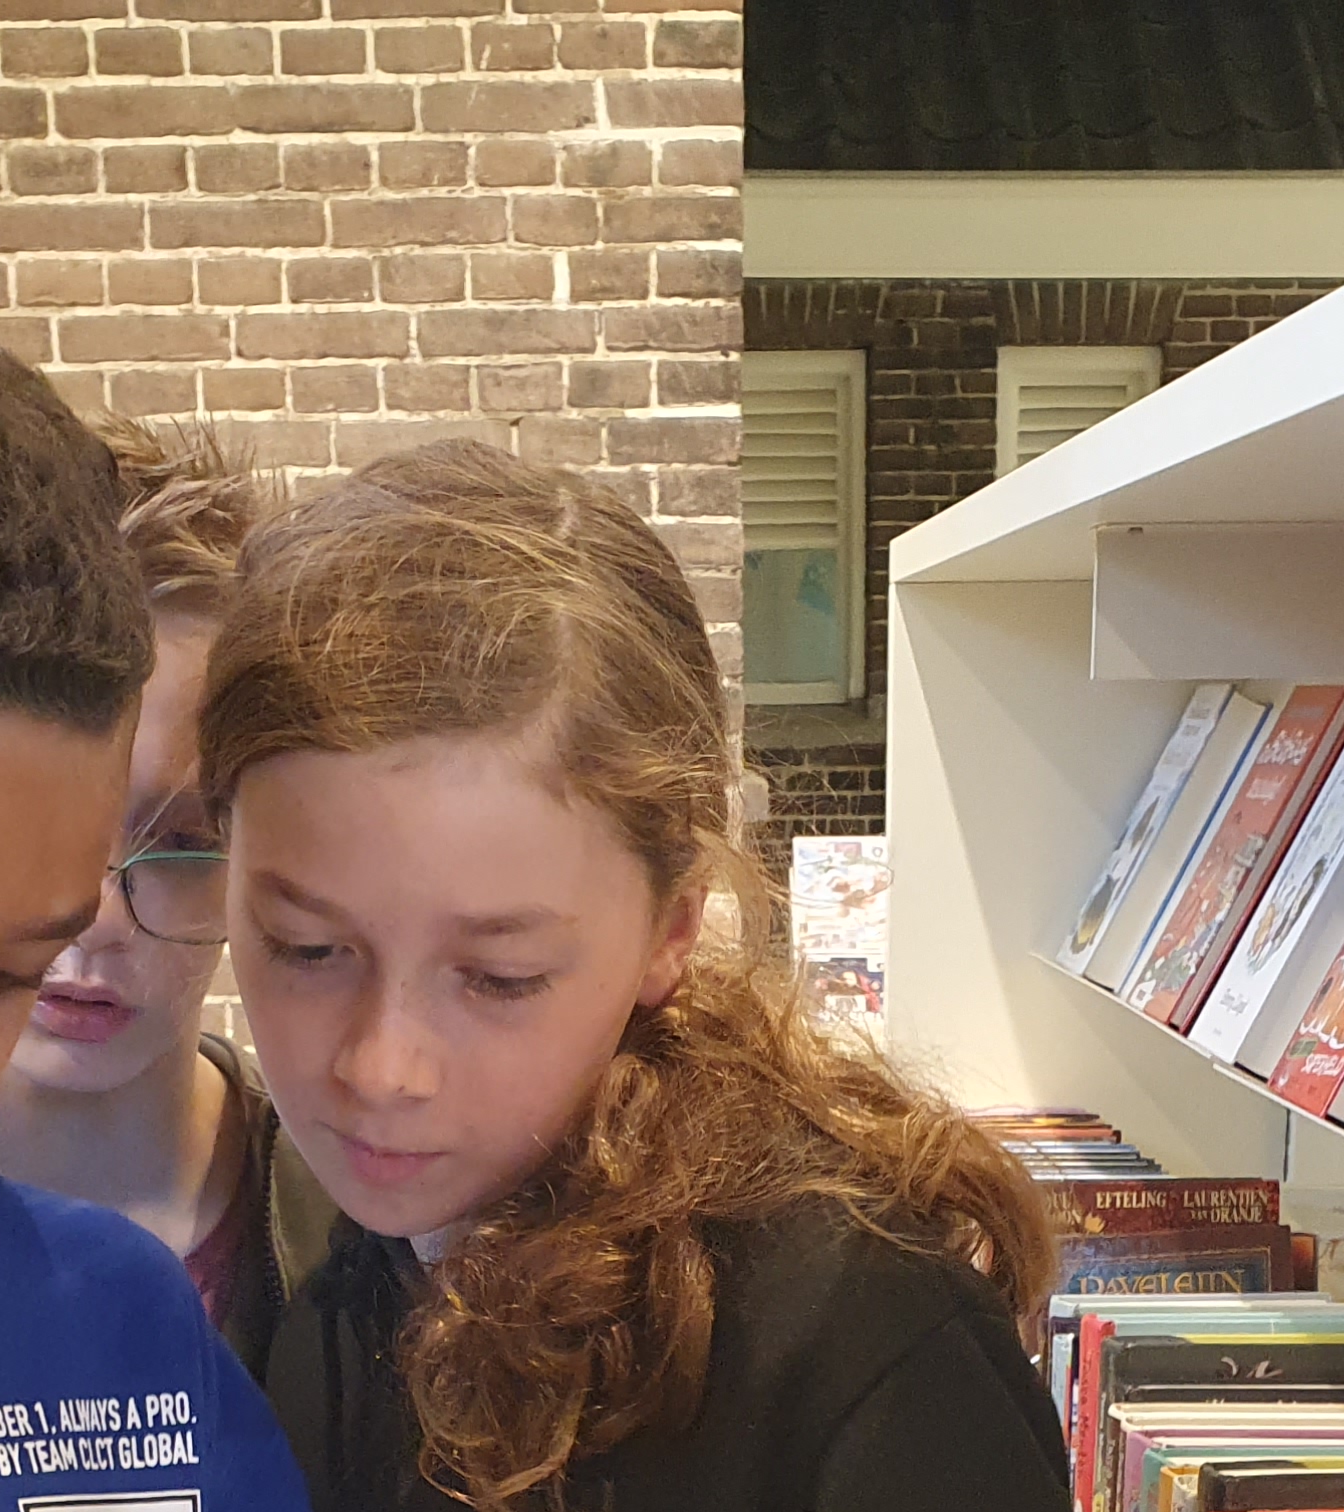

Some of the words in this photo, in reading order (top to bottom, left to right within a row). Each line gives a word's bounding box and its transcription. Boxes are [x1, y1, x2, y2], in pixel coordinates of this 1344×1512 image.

[1096, 1189, 1167, 1209] EFTELING
[60, 1396, 121, 1433] ALWAYS
[126, 1397, 142, 1430] A
[146, 1390, 198, 1428] PRO.
[26, 1437, 77, 1474] TEAM
[78, 1437, 117, 1472] CLCT
[118, 1430, 200, 1470] GLOBAL
